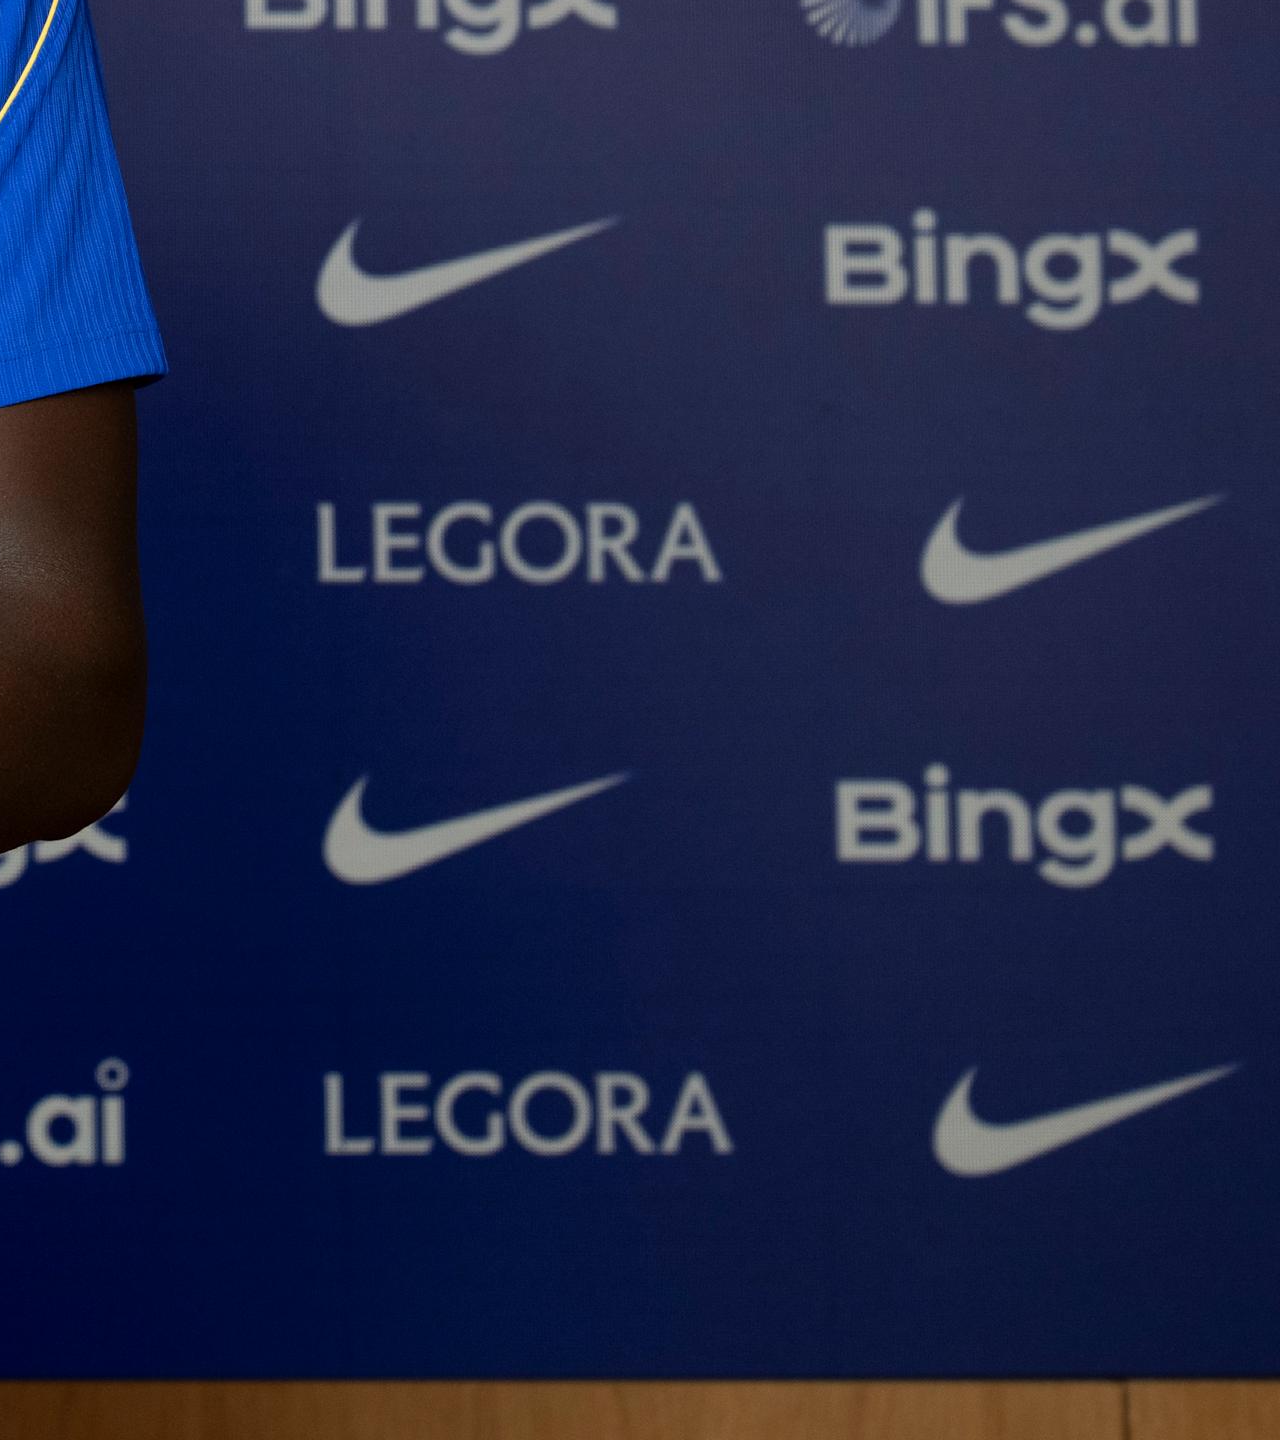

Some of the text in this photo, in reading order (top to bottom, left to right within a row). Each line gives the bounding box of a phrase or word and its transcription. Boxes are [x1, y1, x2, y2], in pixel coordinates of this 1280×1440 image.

[823, 208, 1200, 331] Bingx
[317, 500, 723, 586] LEGORA
[835, 763, 1215, 888] Bingx
[324, 1070, 734, 1157] LEGORA
